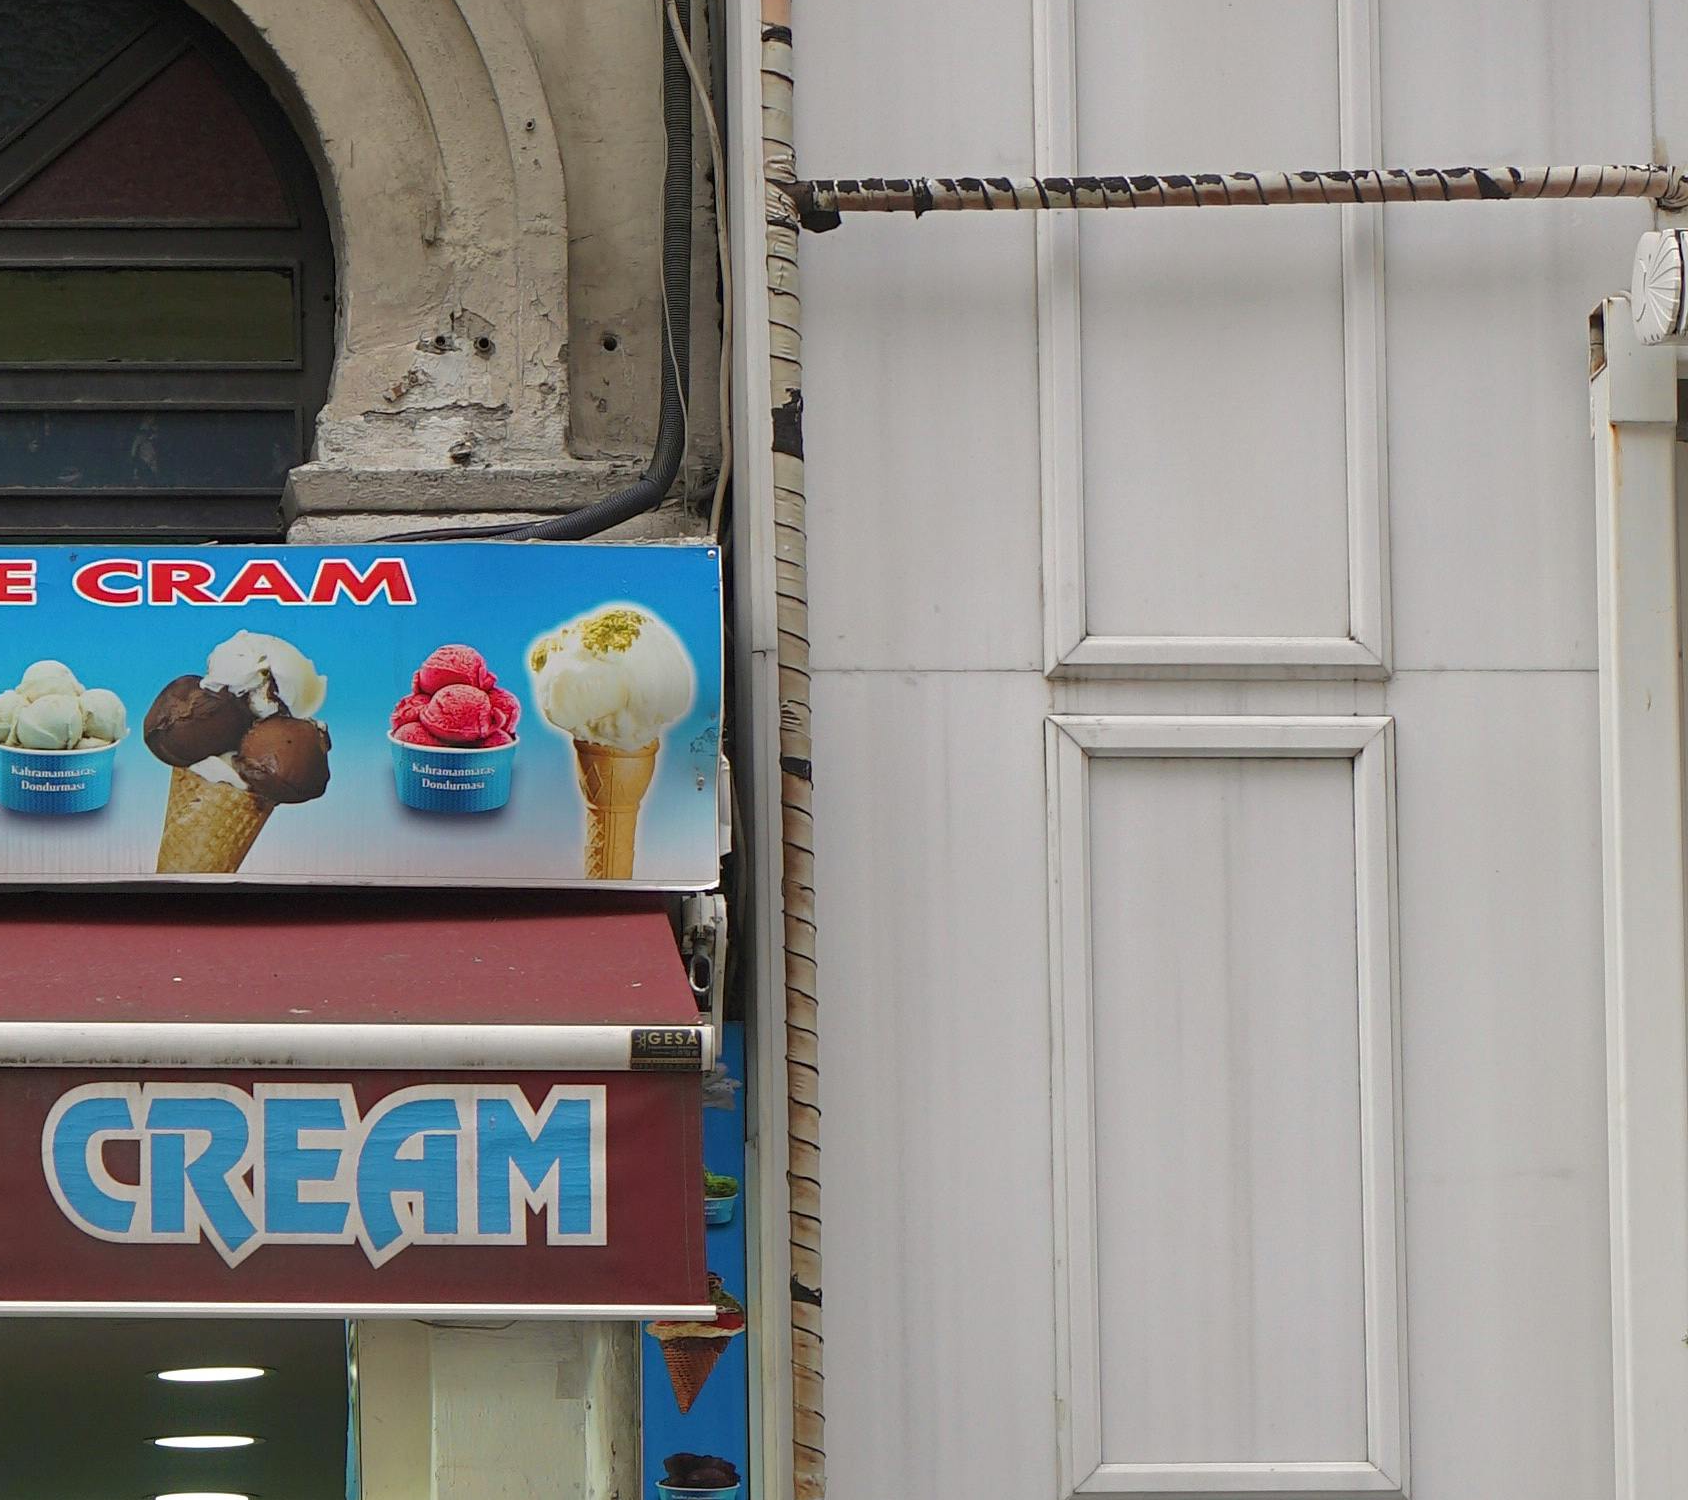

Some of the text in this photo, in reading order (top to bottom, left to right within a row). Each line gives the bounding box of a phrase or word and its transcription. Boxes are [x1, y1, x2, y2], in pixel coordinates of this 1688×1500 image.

[73, 558, 417, 607] CRAM
[648, 1032, 698, 1045] GESA
[42, 1083, 608, 1270] CREAM
